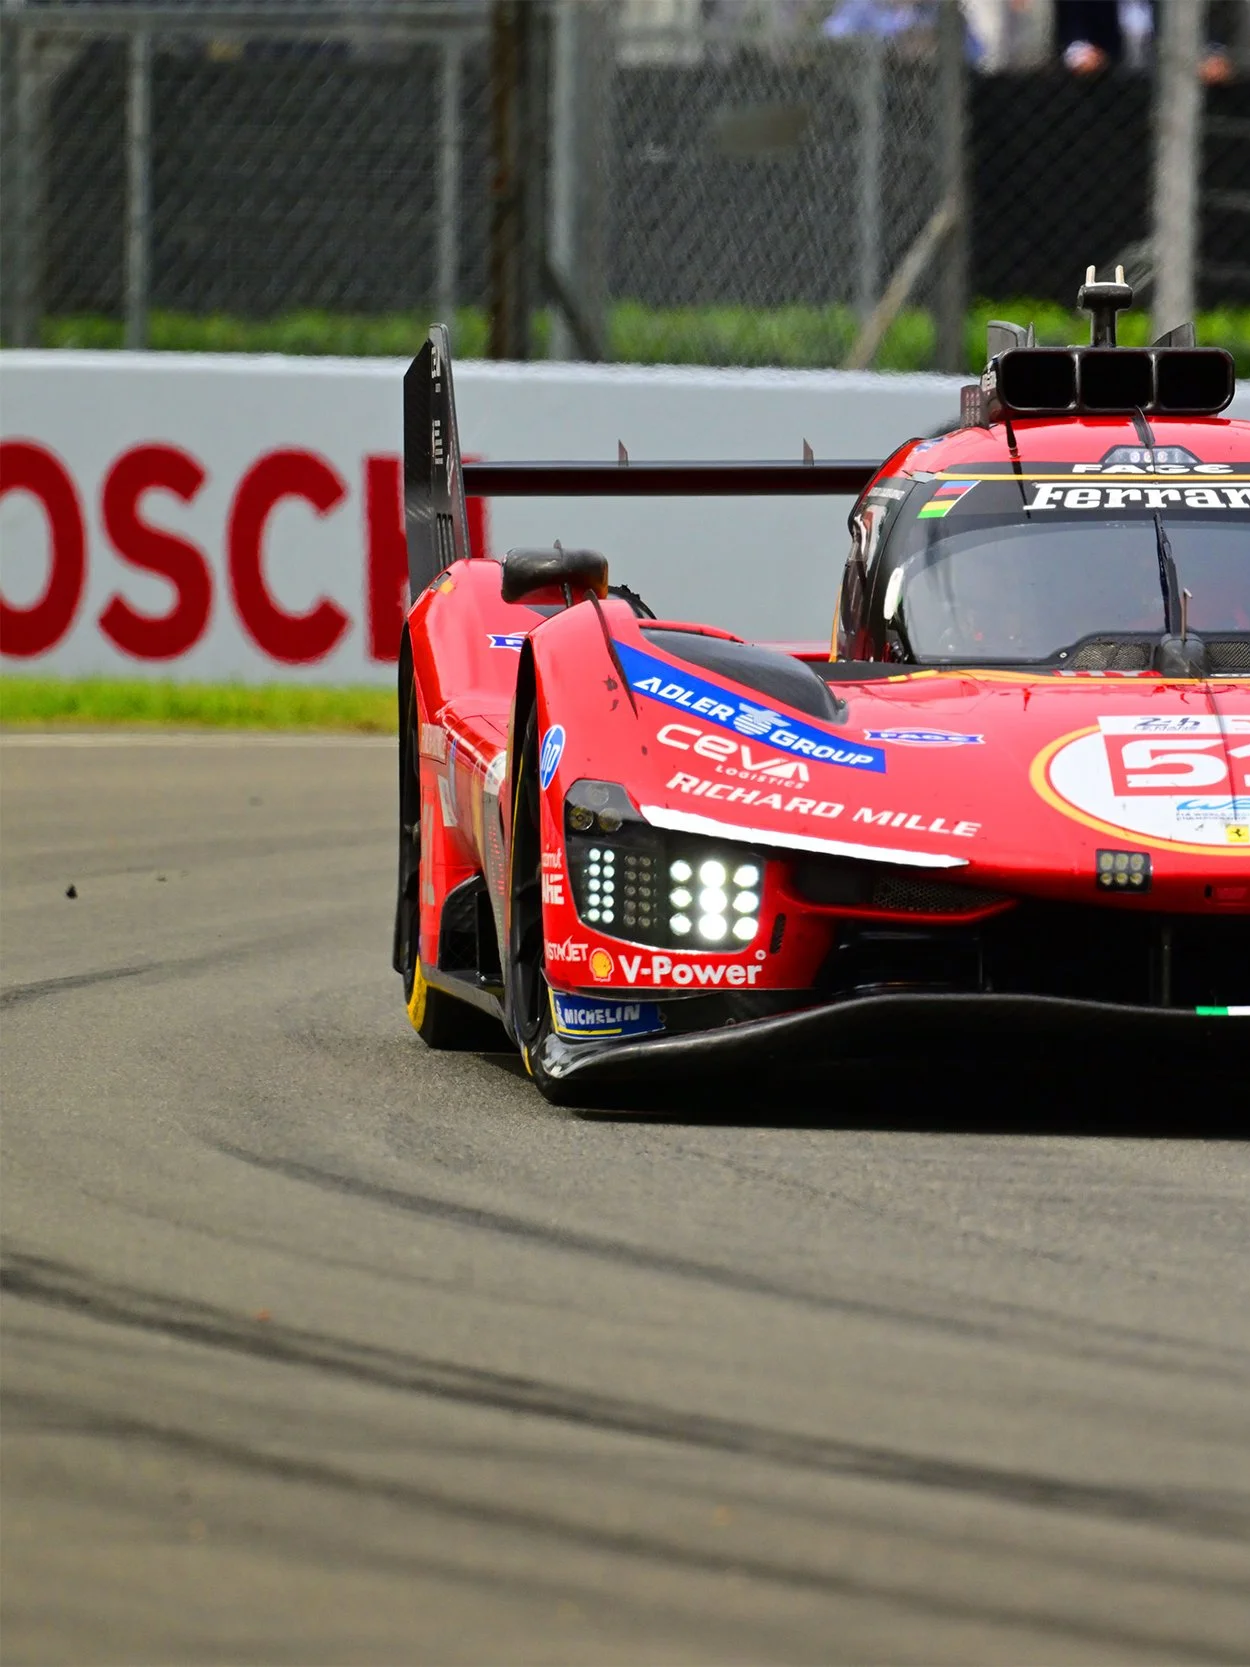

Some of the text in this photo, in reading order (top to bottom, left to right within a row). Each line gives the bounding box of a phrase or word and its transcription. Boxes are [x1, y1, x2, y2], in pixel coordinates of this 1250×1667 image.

[633, 676, 874, 766] ADLER GROUP
[714, 764, 805, 789] LOGISTICS
[666, 772, 983, 838] RICHARD MILLE
[618, 953, 763, 985] V-Power
[564, 1004, 641, 1025] MICHELIN
